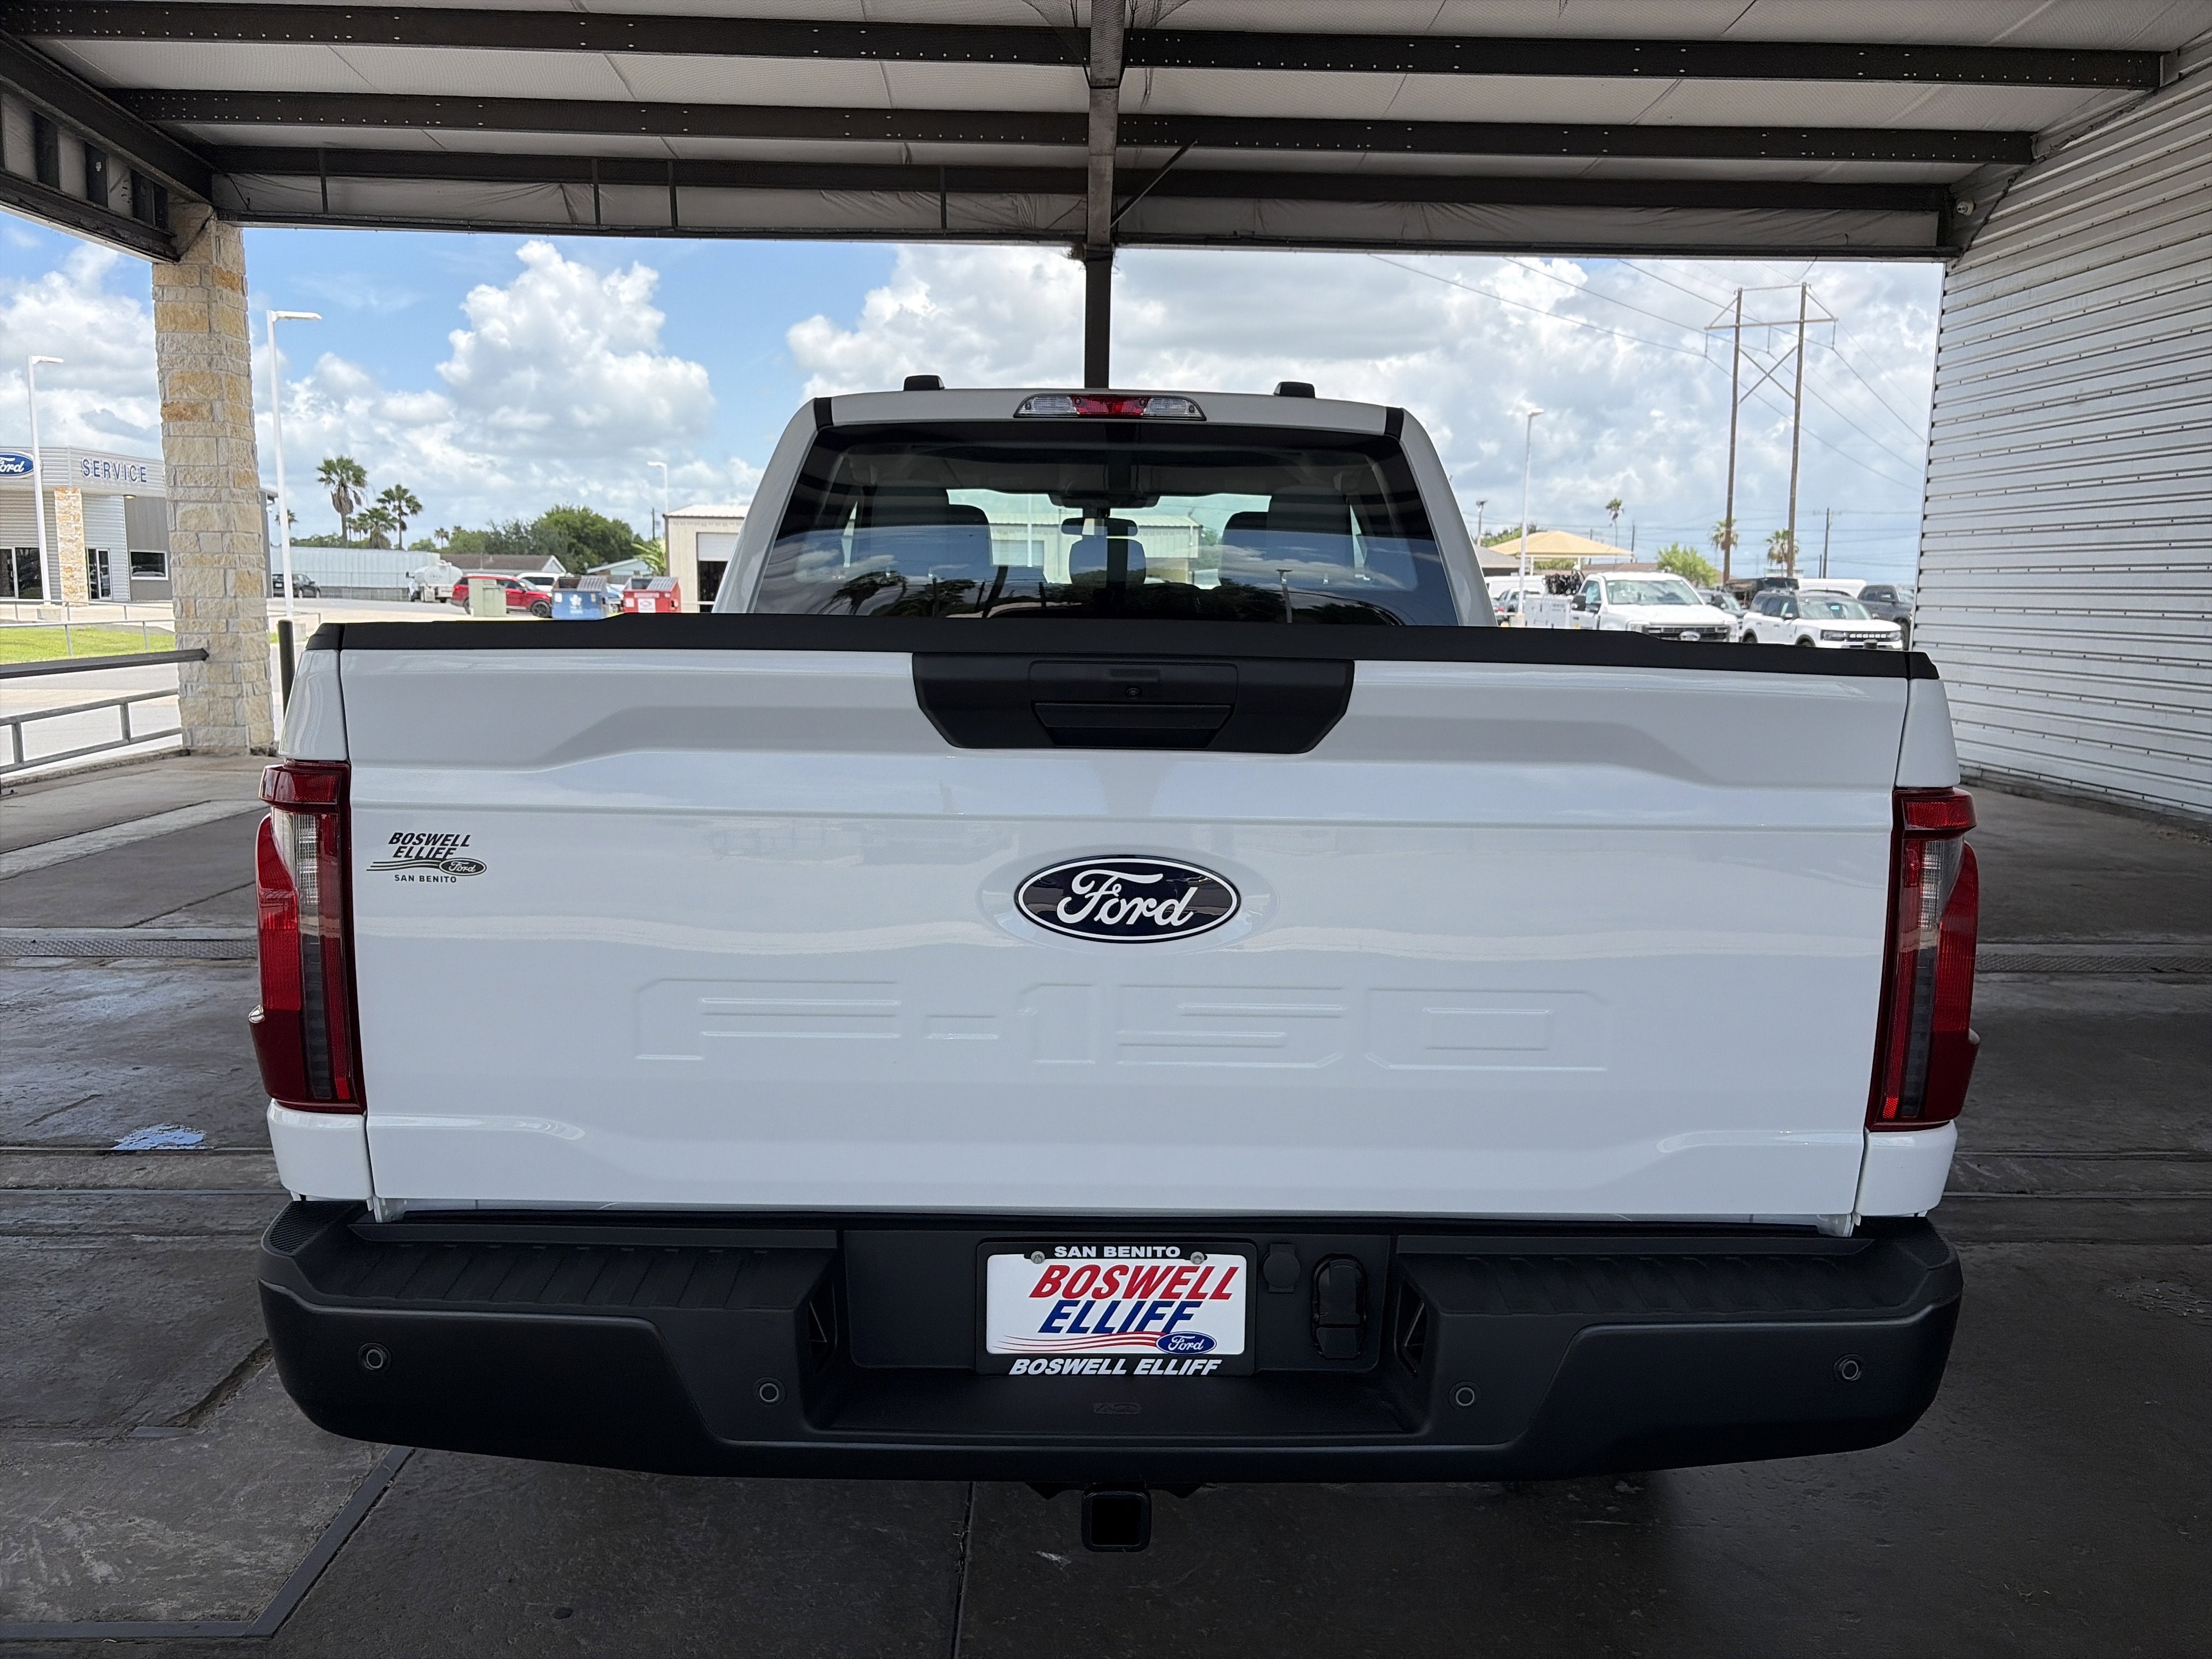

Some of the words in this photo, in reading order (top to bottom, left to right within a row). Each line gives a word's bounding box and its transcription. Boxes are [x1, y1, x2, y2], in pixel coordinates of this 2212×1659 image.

[82, 459, 147, 483] SERVICE
[388, 832, 471, 847] BOSWELL
[392, 846, 457, 860] ELLIFF
[448, 861, 477, 873] Ford
[419, 875, 457, 883] BENITO
[1056, 869, 1199, 926] Ford
[635, 978, 1613, 1071] F-150
[1054, 1246, 1097, 1257] SAN
[1103, 1246, 1181, 1257] BENITO
[1028, 1264, 1240, 1300] BOSWELL
[1037, 1300, 1204, 1335] ELLIFF
[1167, 1335, 1205, 1351] Ford
[1008, 1358, 1127, 1376] BOSWELL
[1133, 1359, 1223, 1376] ELLIFF
